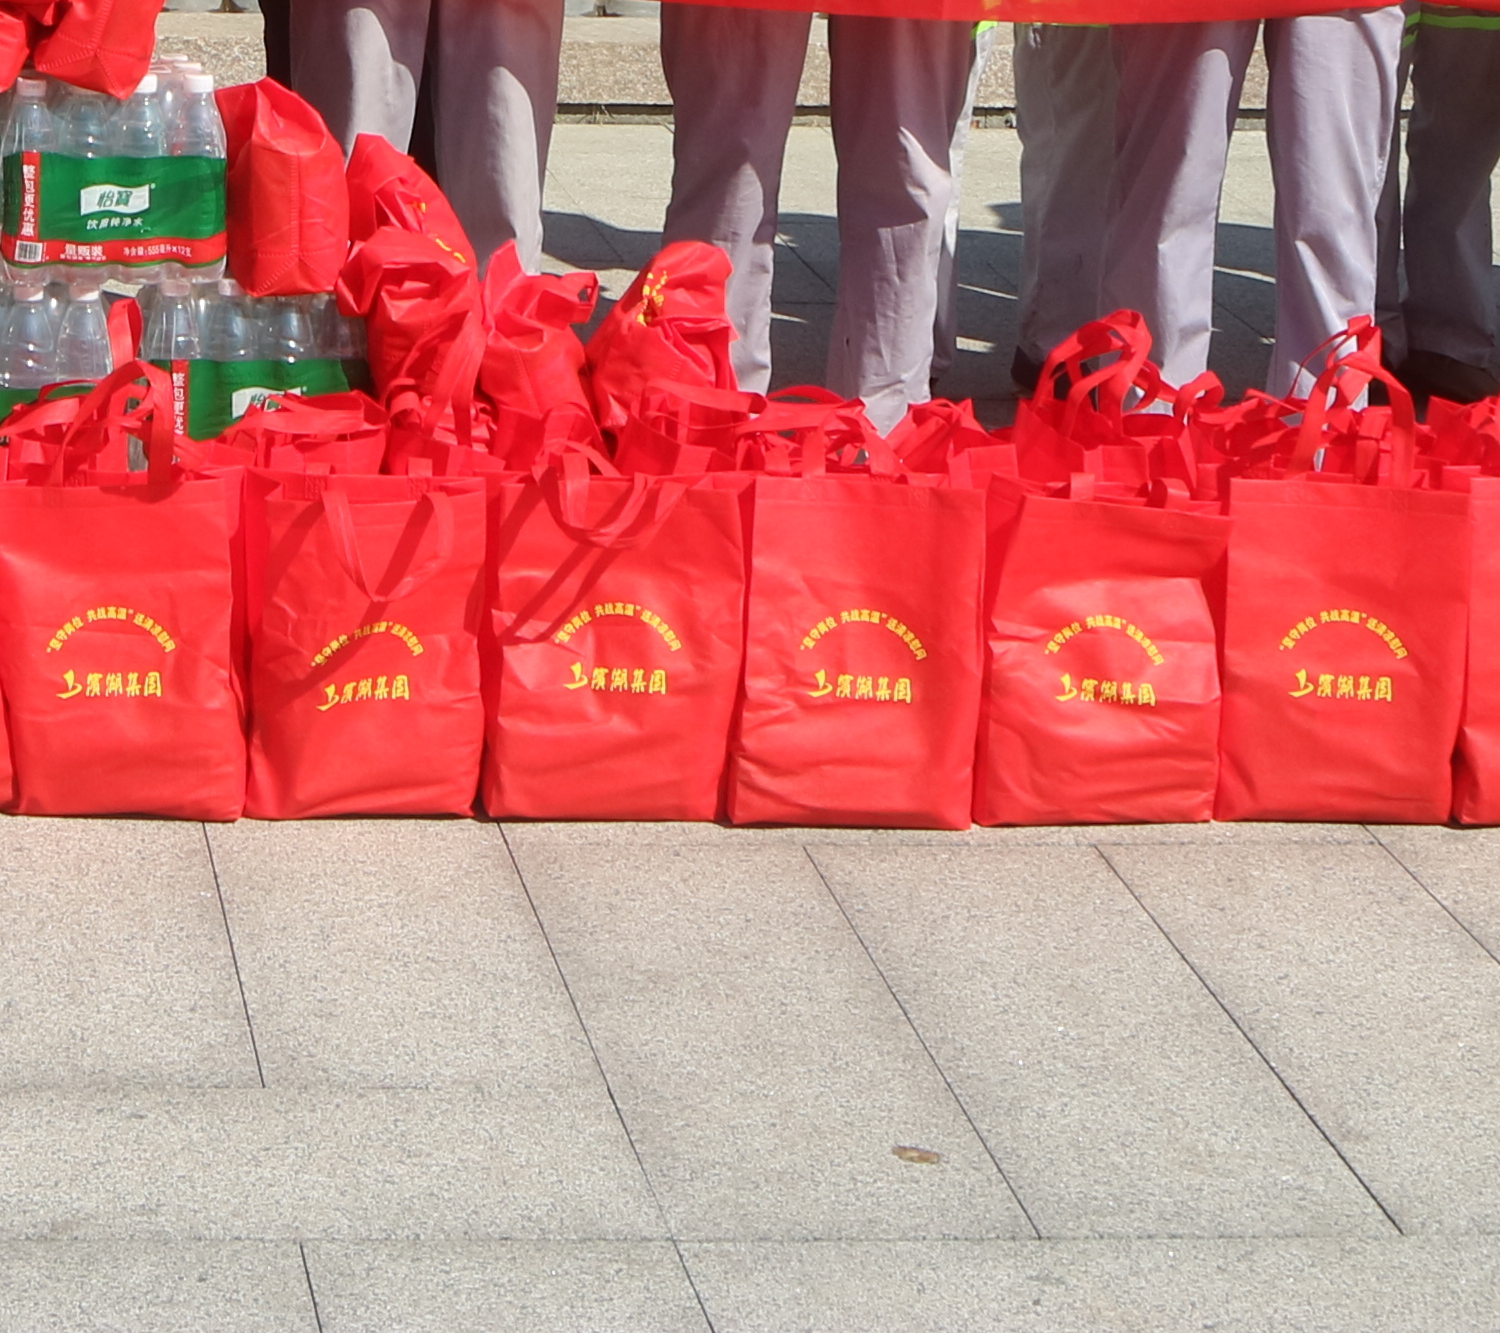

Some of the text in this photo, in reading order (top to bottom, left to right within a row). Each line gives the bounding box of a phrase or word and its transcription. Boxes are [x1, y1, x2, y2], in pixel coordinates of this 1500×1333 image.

[20, 165, 36, 236] 整包更优惠
